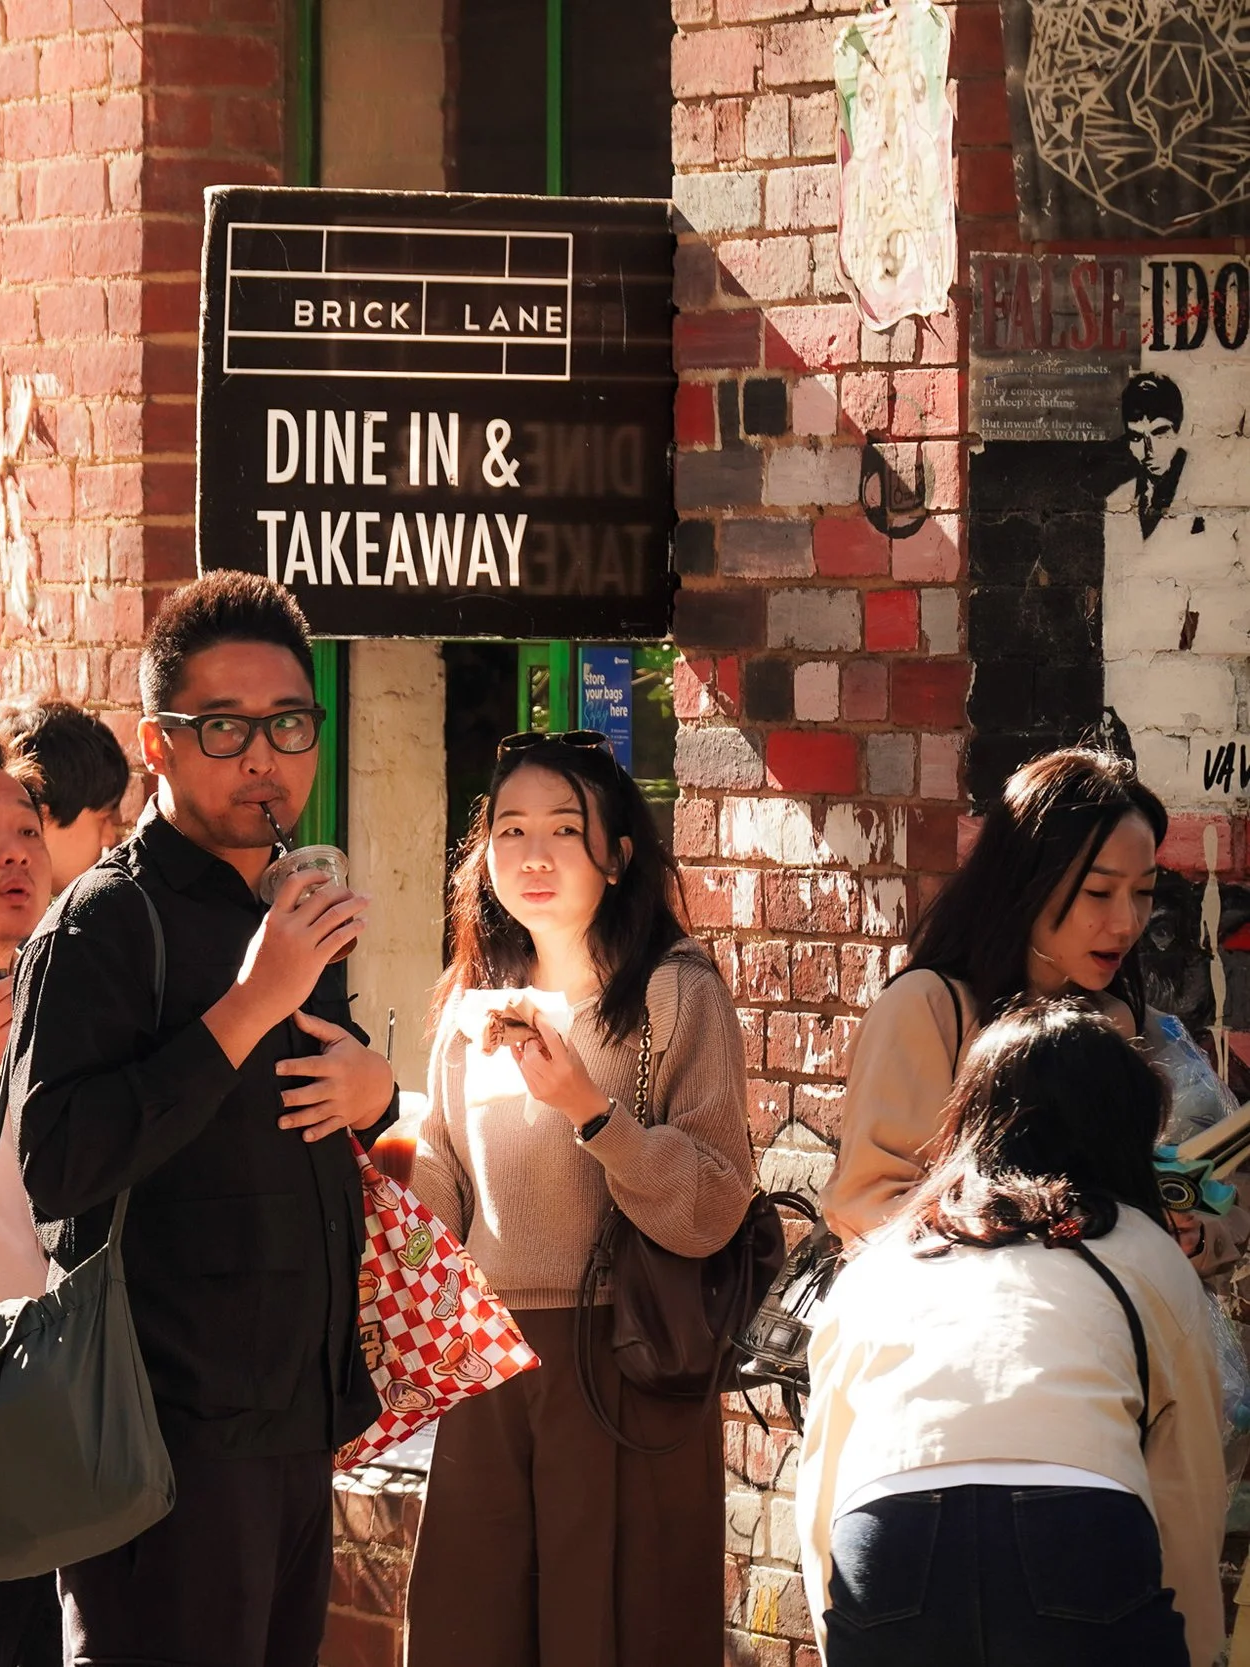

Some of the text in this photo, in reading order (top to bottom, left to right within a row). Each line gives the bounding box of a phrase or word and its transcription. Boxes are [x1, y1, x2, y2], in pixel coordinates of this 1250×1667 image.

[981, 260, 1129, 350] FALSE
[294, 300, 562, 333] BRICK LANE
[1064, 363, 1111, 376] prophets.
[982, 386, 1007, 398] They
[981, 396, 1079, 410] in sheep's clothing.
[981, 418, 1001, 429] But
[1003, 418, 1049, 431] inwardly
[1051, 418, 1073, 431] they
[266, 408, 521, 488] DINE IN &
[256, 509, 528, 588] TAKEAWAY
[585, 673, 605, 685] store
[585, 686, 623, 703] your bags
[610, 703, 628, 717] here
